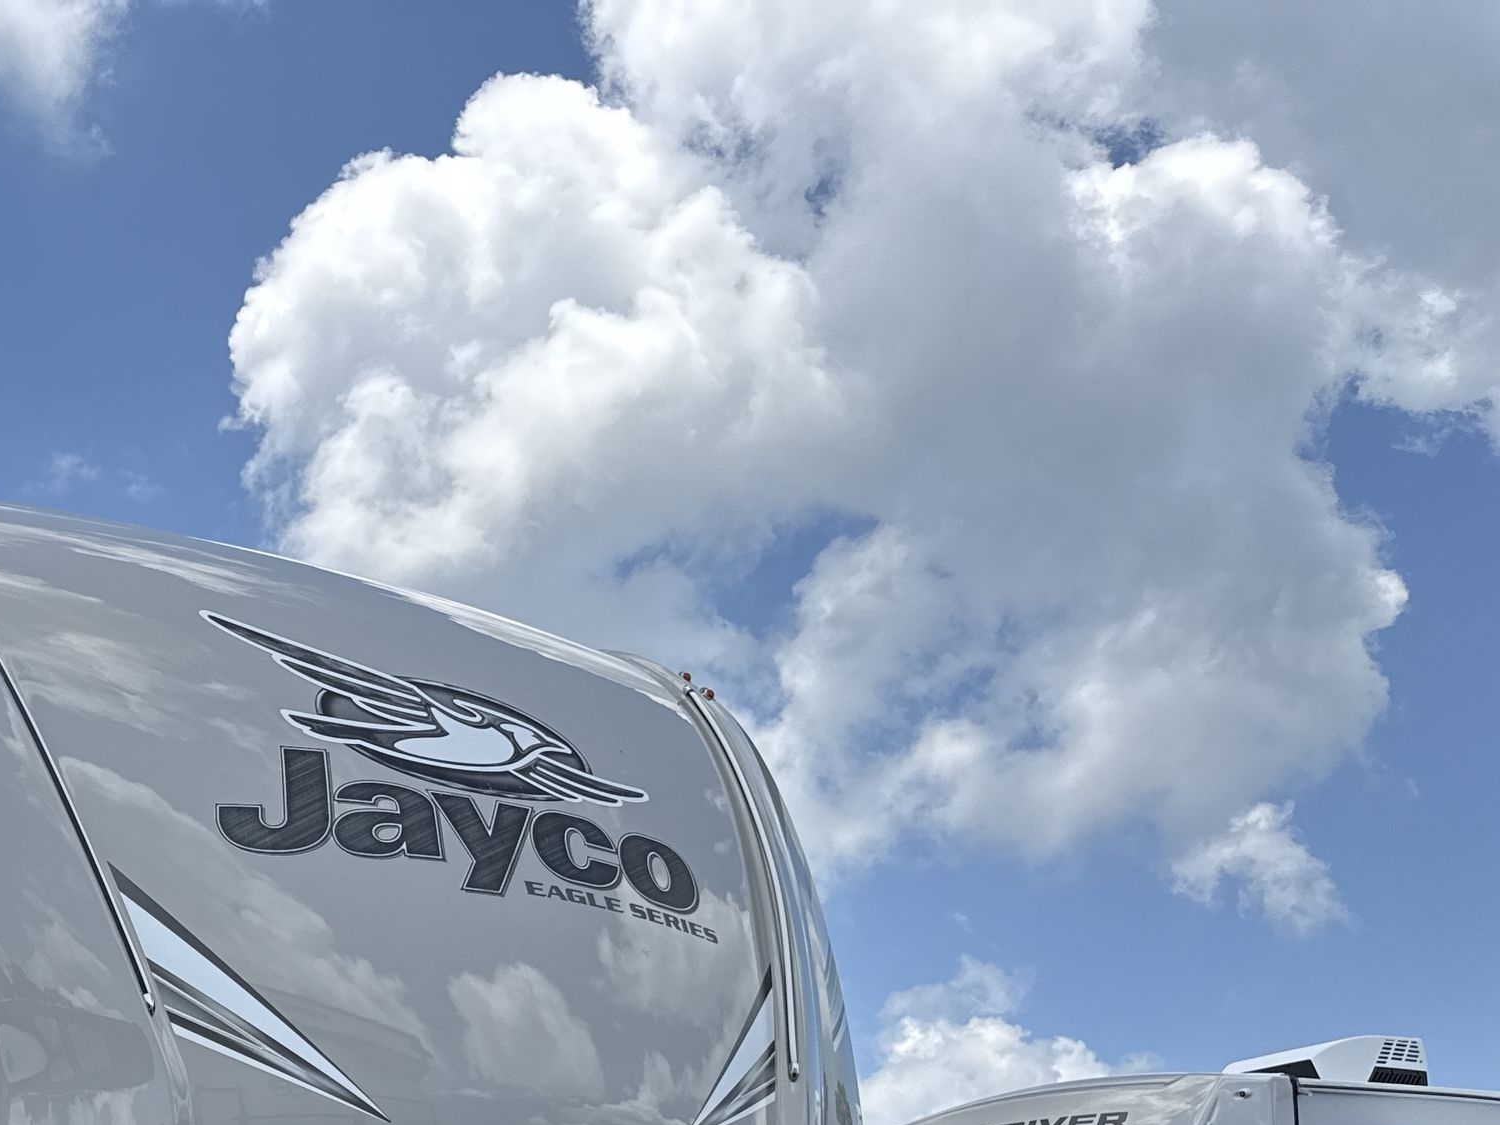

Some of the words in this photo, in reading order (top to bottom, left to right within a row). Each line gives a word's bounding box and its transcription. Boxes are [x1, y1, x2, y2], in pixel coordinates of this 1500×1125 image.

[215, 745, 700, 915] Jayco
[524, 880, 625, 914] EAGLE
[628, 902, 719, 944] SERIES
